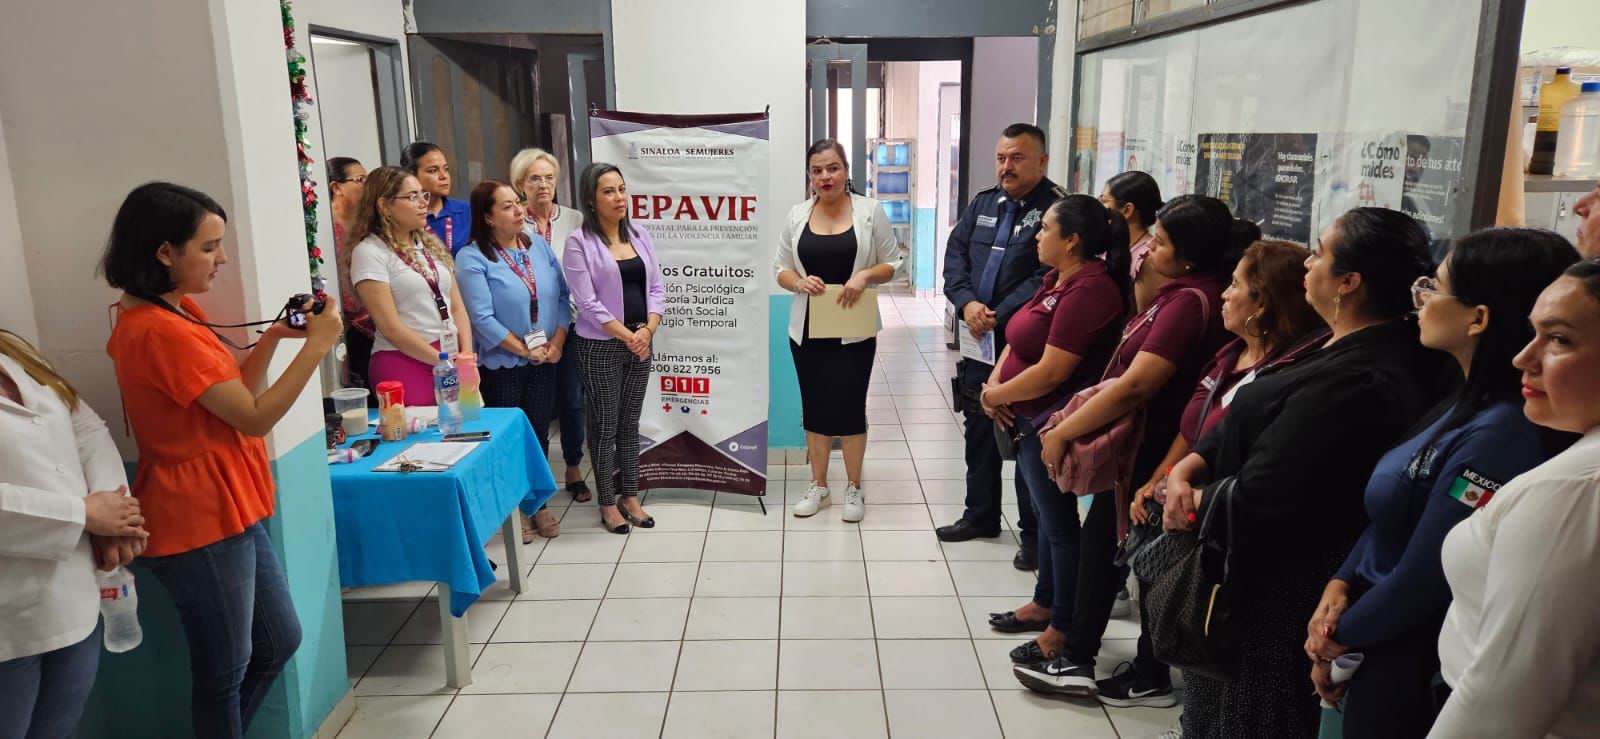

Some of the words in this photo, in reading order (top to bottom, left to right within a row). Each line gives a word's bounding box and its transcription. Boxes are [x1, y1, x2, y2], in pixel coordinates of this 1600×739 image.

[640, 147, 680, 156] SINALOA
[685, 148, 735, 157] SEMUJERES
[1360, 142, 1400, 161] ¿Cómo
[1360, 160, 1394, 179] mides
[659, 264, 679, 277] os
[682, 265, 755, 278] Gratuitos:
[664, 283, 683, 294] ión
[685, 284, 745, 297] Psicológica
[692, 296, 735, 305] Jurídica
[695, 307, 728, 317] Social
[659, 318, 685, 329] ugio
[687, 318, 737, 329] Temporal
[652, 352, 704, 363] Llámanos
[649, 364, 671, 373] 800
[673, 365, 692, 374] 822
[694, 366, 721, 375] 7956
[664, 378, 705, 392] 911
[661, 396, 710, 405] EMERGENCIAS
[1463, 469, 1502, 492] MEXICO
